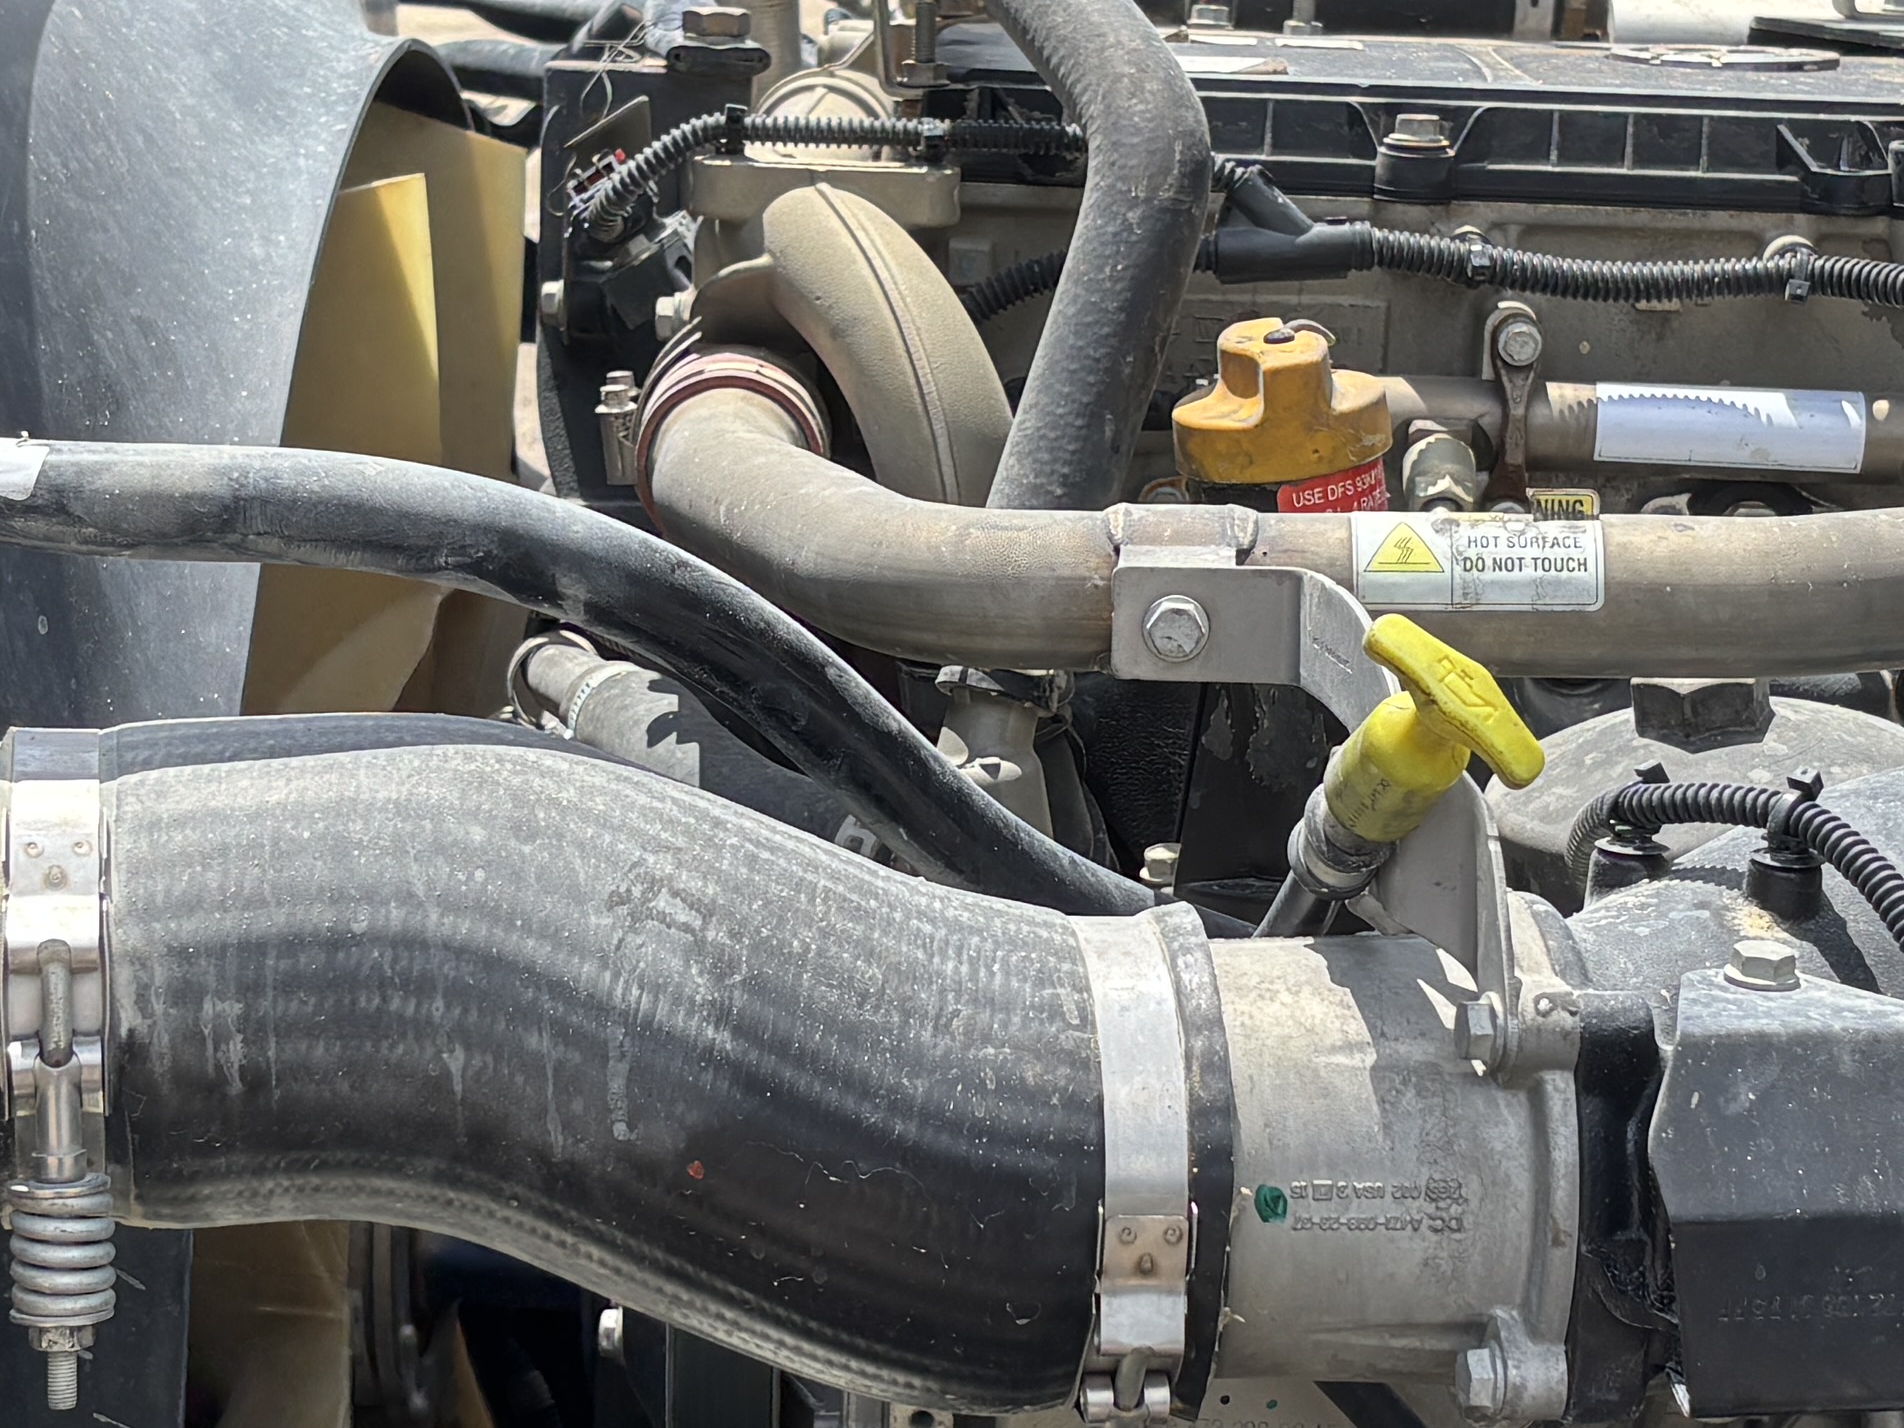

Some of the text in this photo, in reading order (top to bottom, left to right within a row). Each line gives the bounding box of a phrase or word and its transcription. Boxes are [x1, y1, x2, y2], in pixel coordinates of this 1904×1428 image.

[1292, 488, 1324, 508] USE
[1327, 480, 1355, 501] DFS
[1534, 497, 1584, 522] NING
[1467, 535, 1583, 550] HOT SURFACE
[1463, 557, 1588, 573] DO NOT TOUCH
[1354, 1182, 1385, 1200] USA
